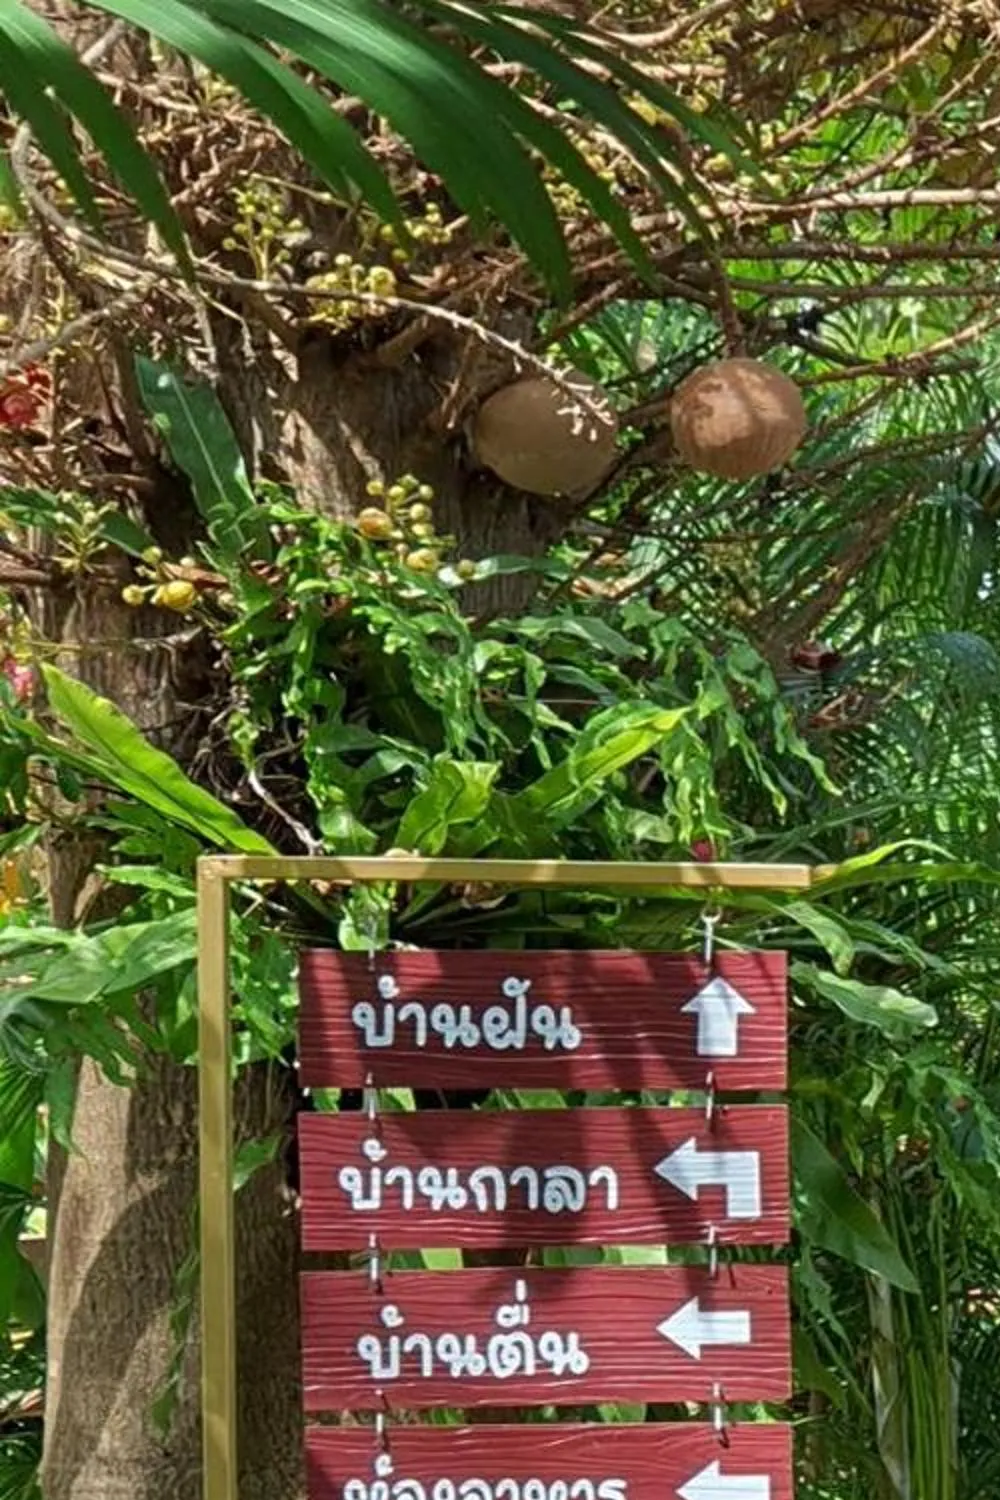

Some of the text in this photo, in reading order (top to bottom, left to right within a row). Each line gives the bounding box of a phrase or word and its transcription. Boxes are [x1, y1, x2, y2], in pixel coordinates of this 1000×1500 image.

[352, 974, 582, 1050] บ้านฝัน
[337, 1138, 619, 1213] บ้านกาลา
[357, 1279, 591, 1379] บ้านตื่น
